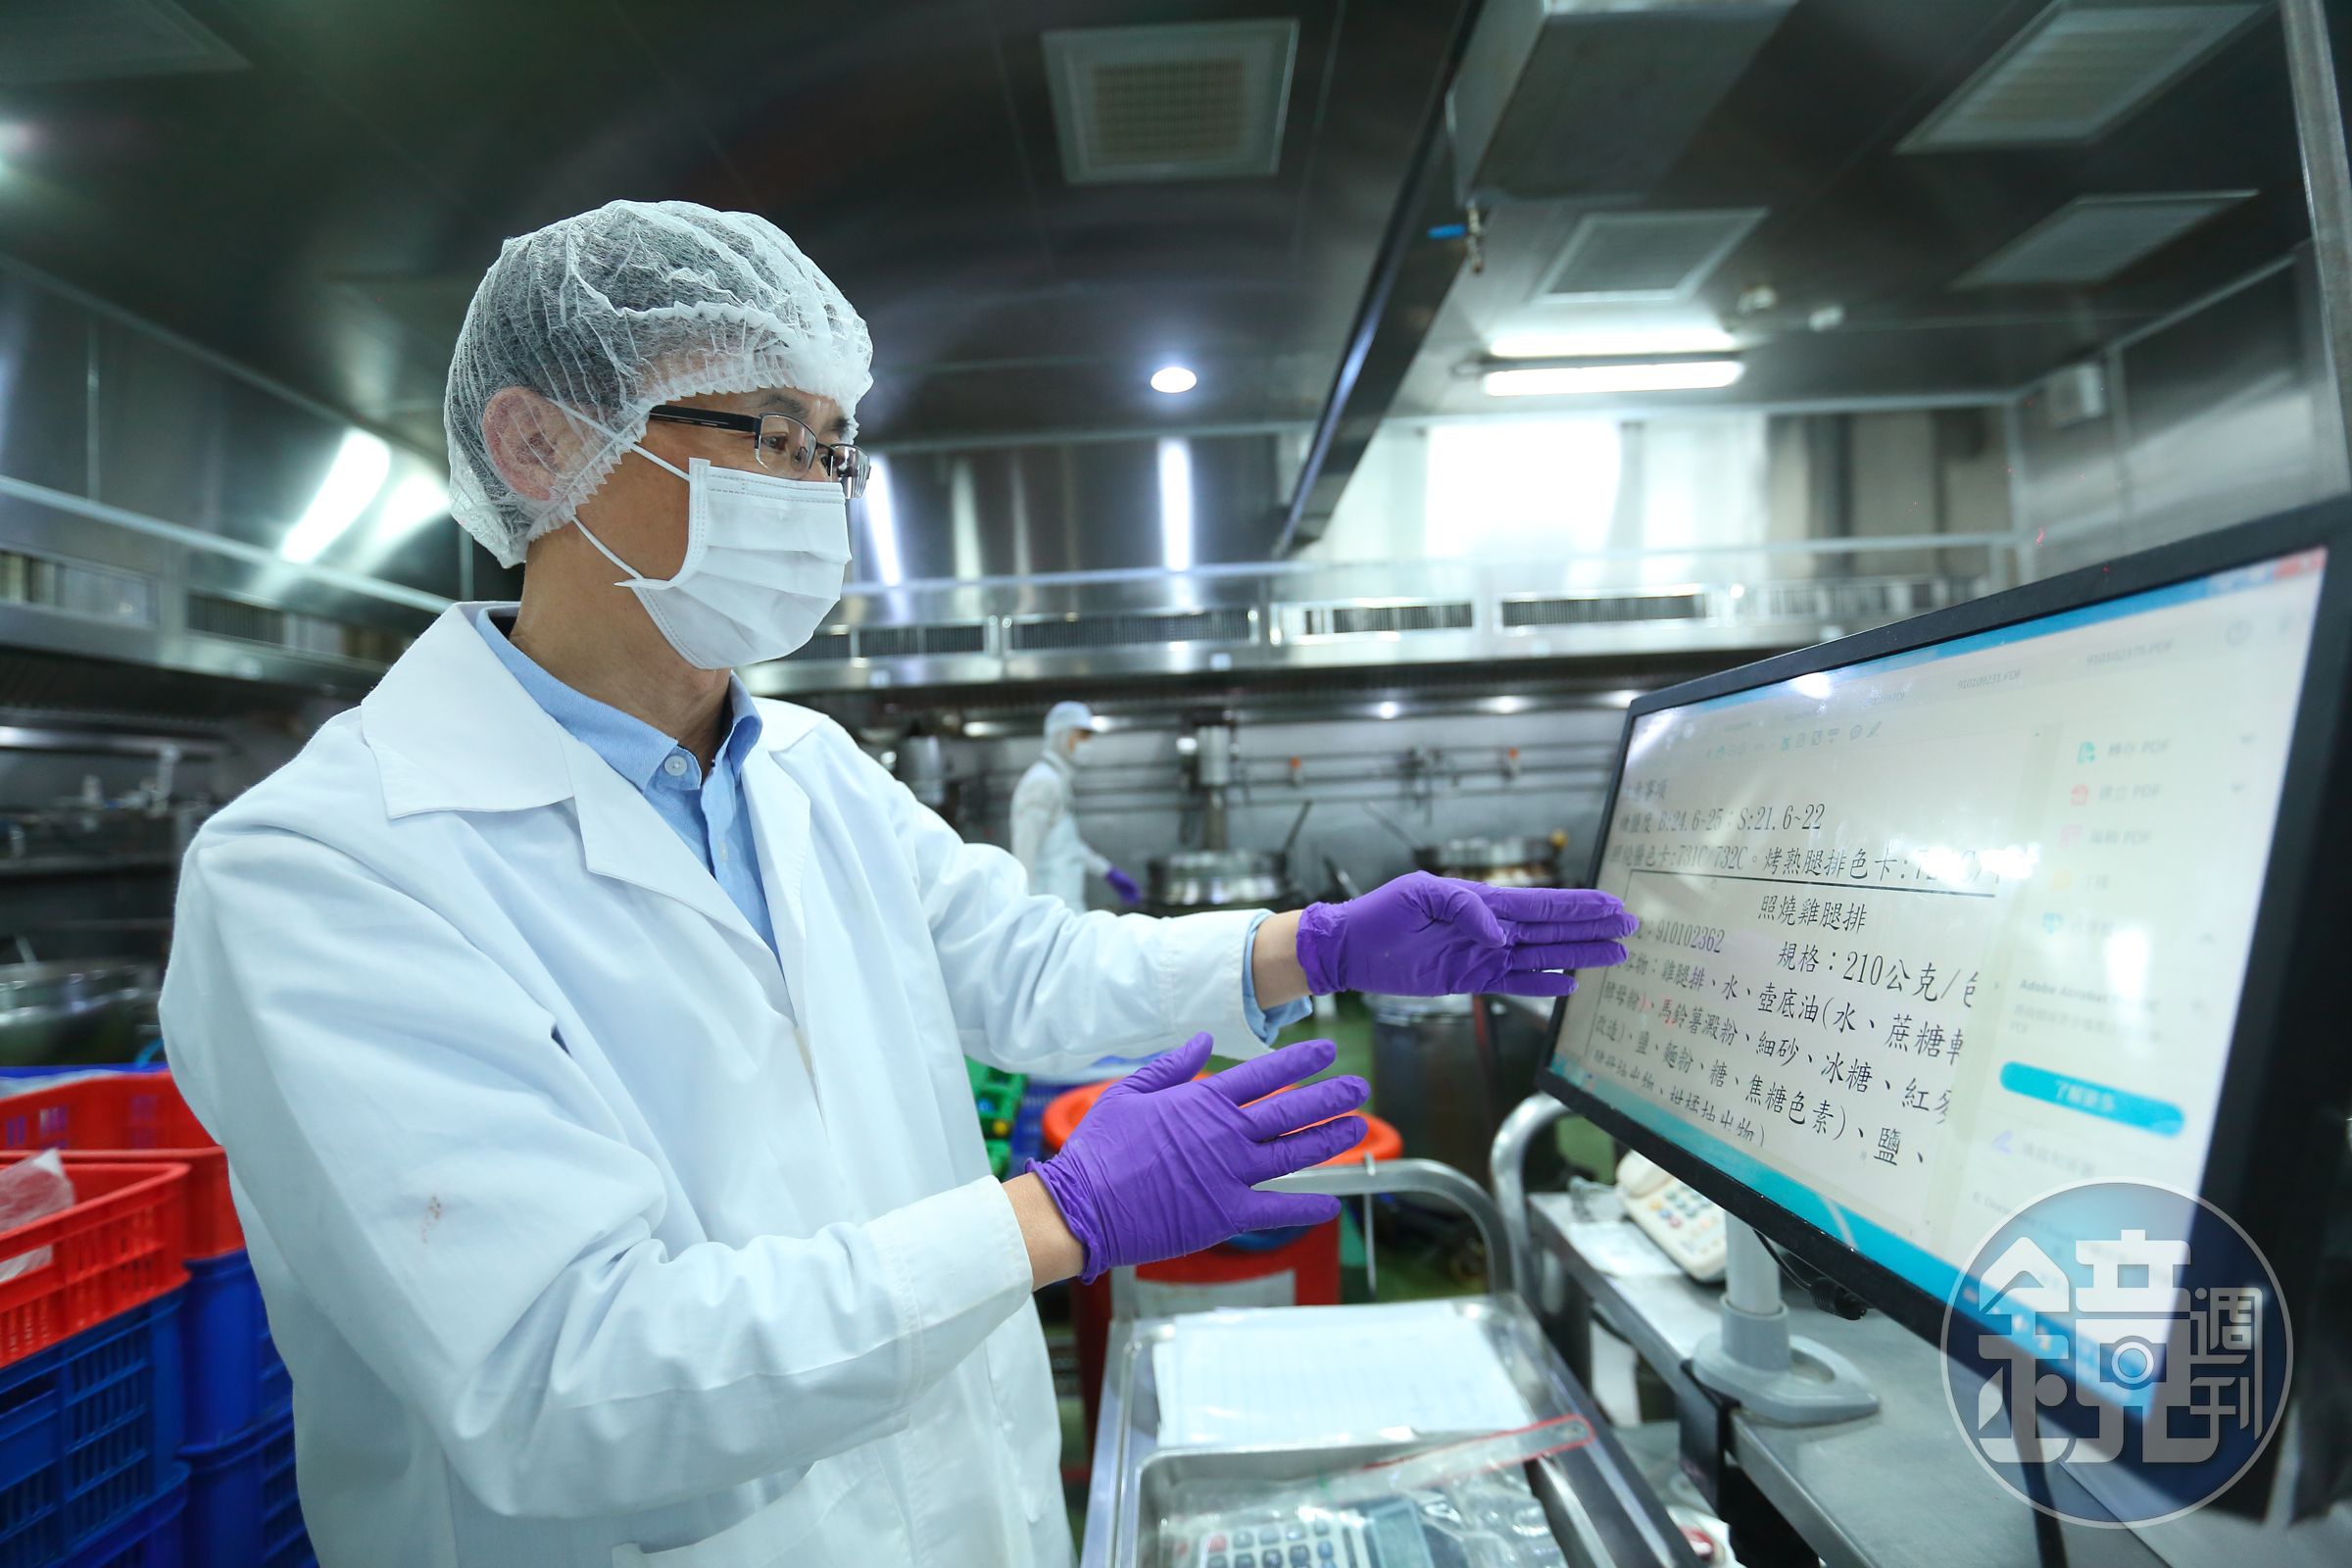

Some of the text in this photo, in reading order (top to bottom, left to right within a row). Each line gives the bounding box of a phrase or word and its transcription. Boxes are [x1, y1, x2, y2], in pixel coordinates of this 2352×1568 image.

[1757, 894, 1867, 933] 照燒雞腿排
